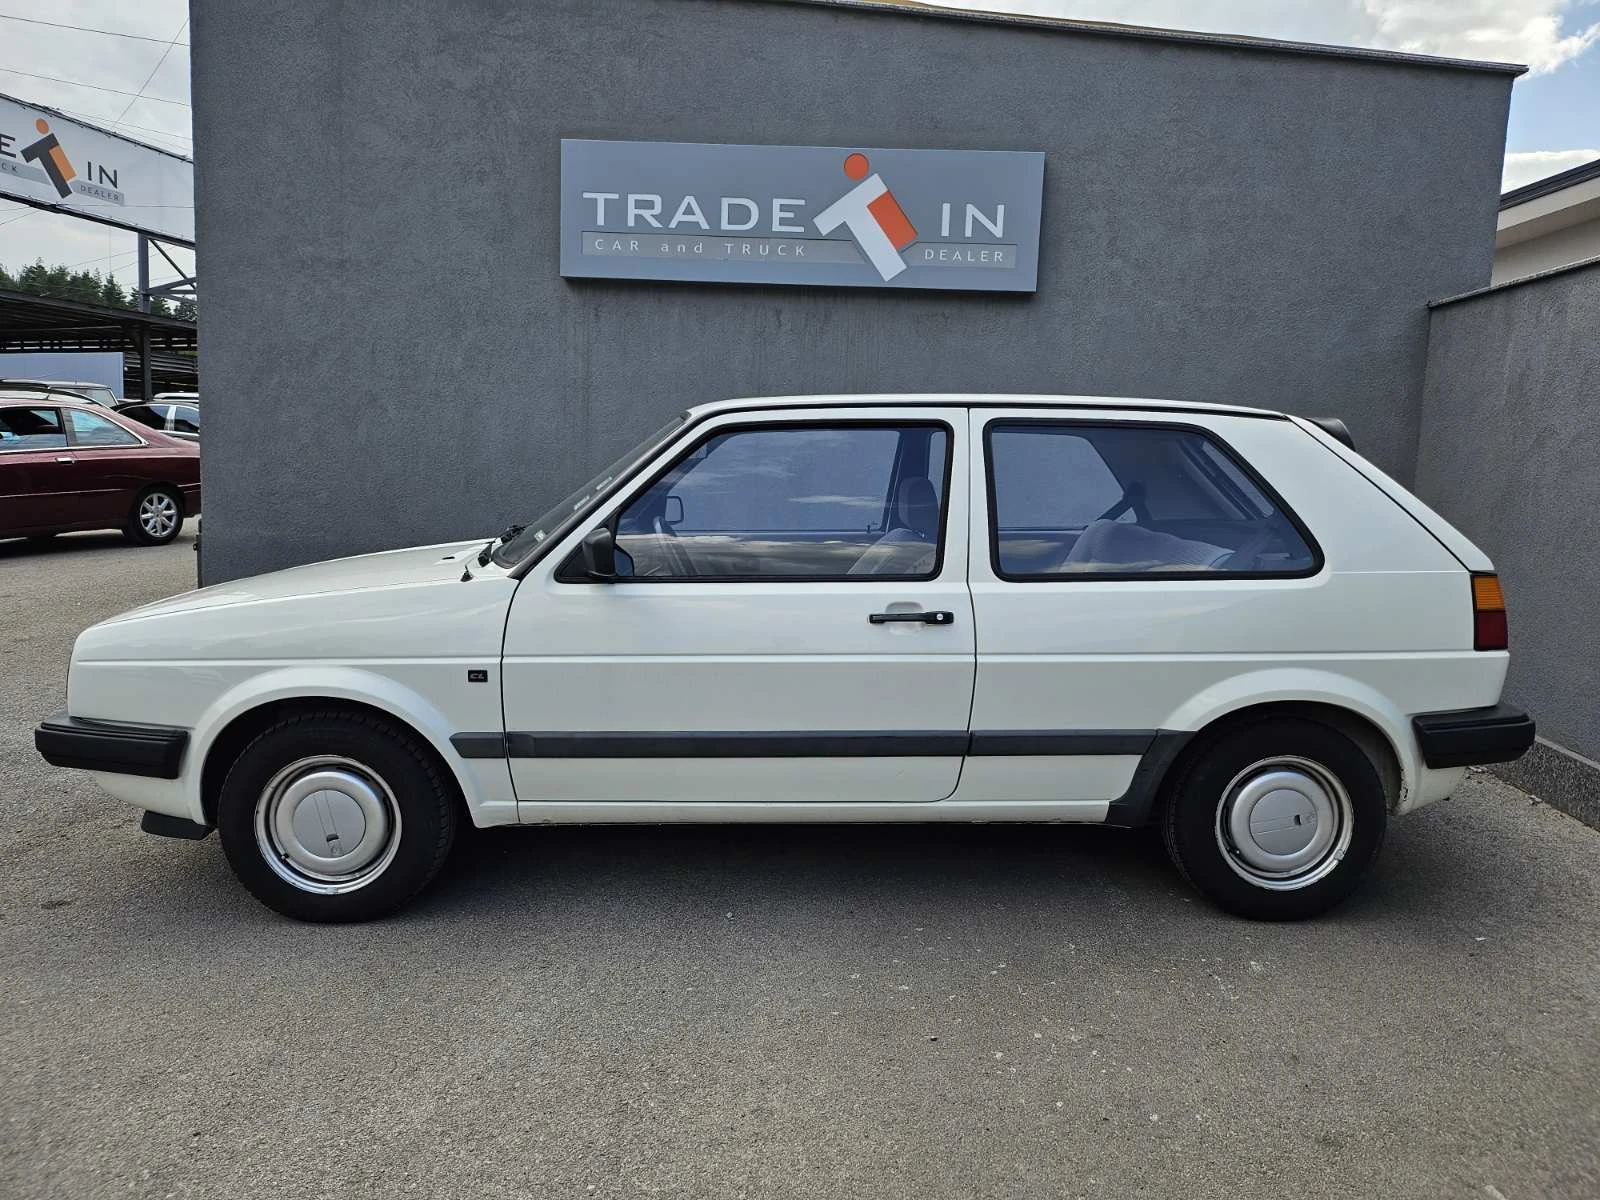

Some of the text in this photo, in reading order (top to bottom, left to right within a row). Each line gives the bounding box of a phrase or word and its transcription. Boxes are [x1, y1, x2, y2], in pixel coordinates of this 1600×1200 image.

[87, 161, 118, 189] IN
[80, 184, 120, 201] DEALER
[582, 191, 806, 234] TRADE
[940, 202, 1005, 239] IN
[594, 238, 806, 257] CAR and TRUCK
[923, 248, 1004, 263] DEALER
